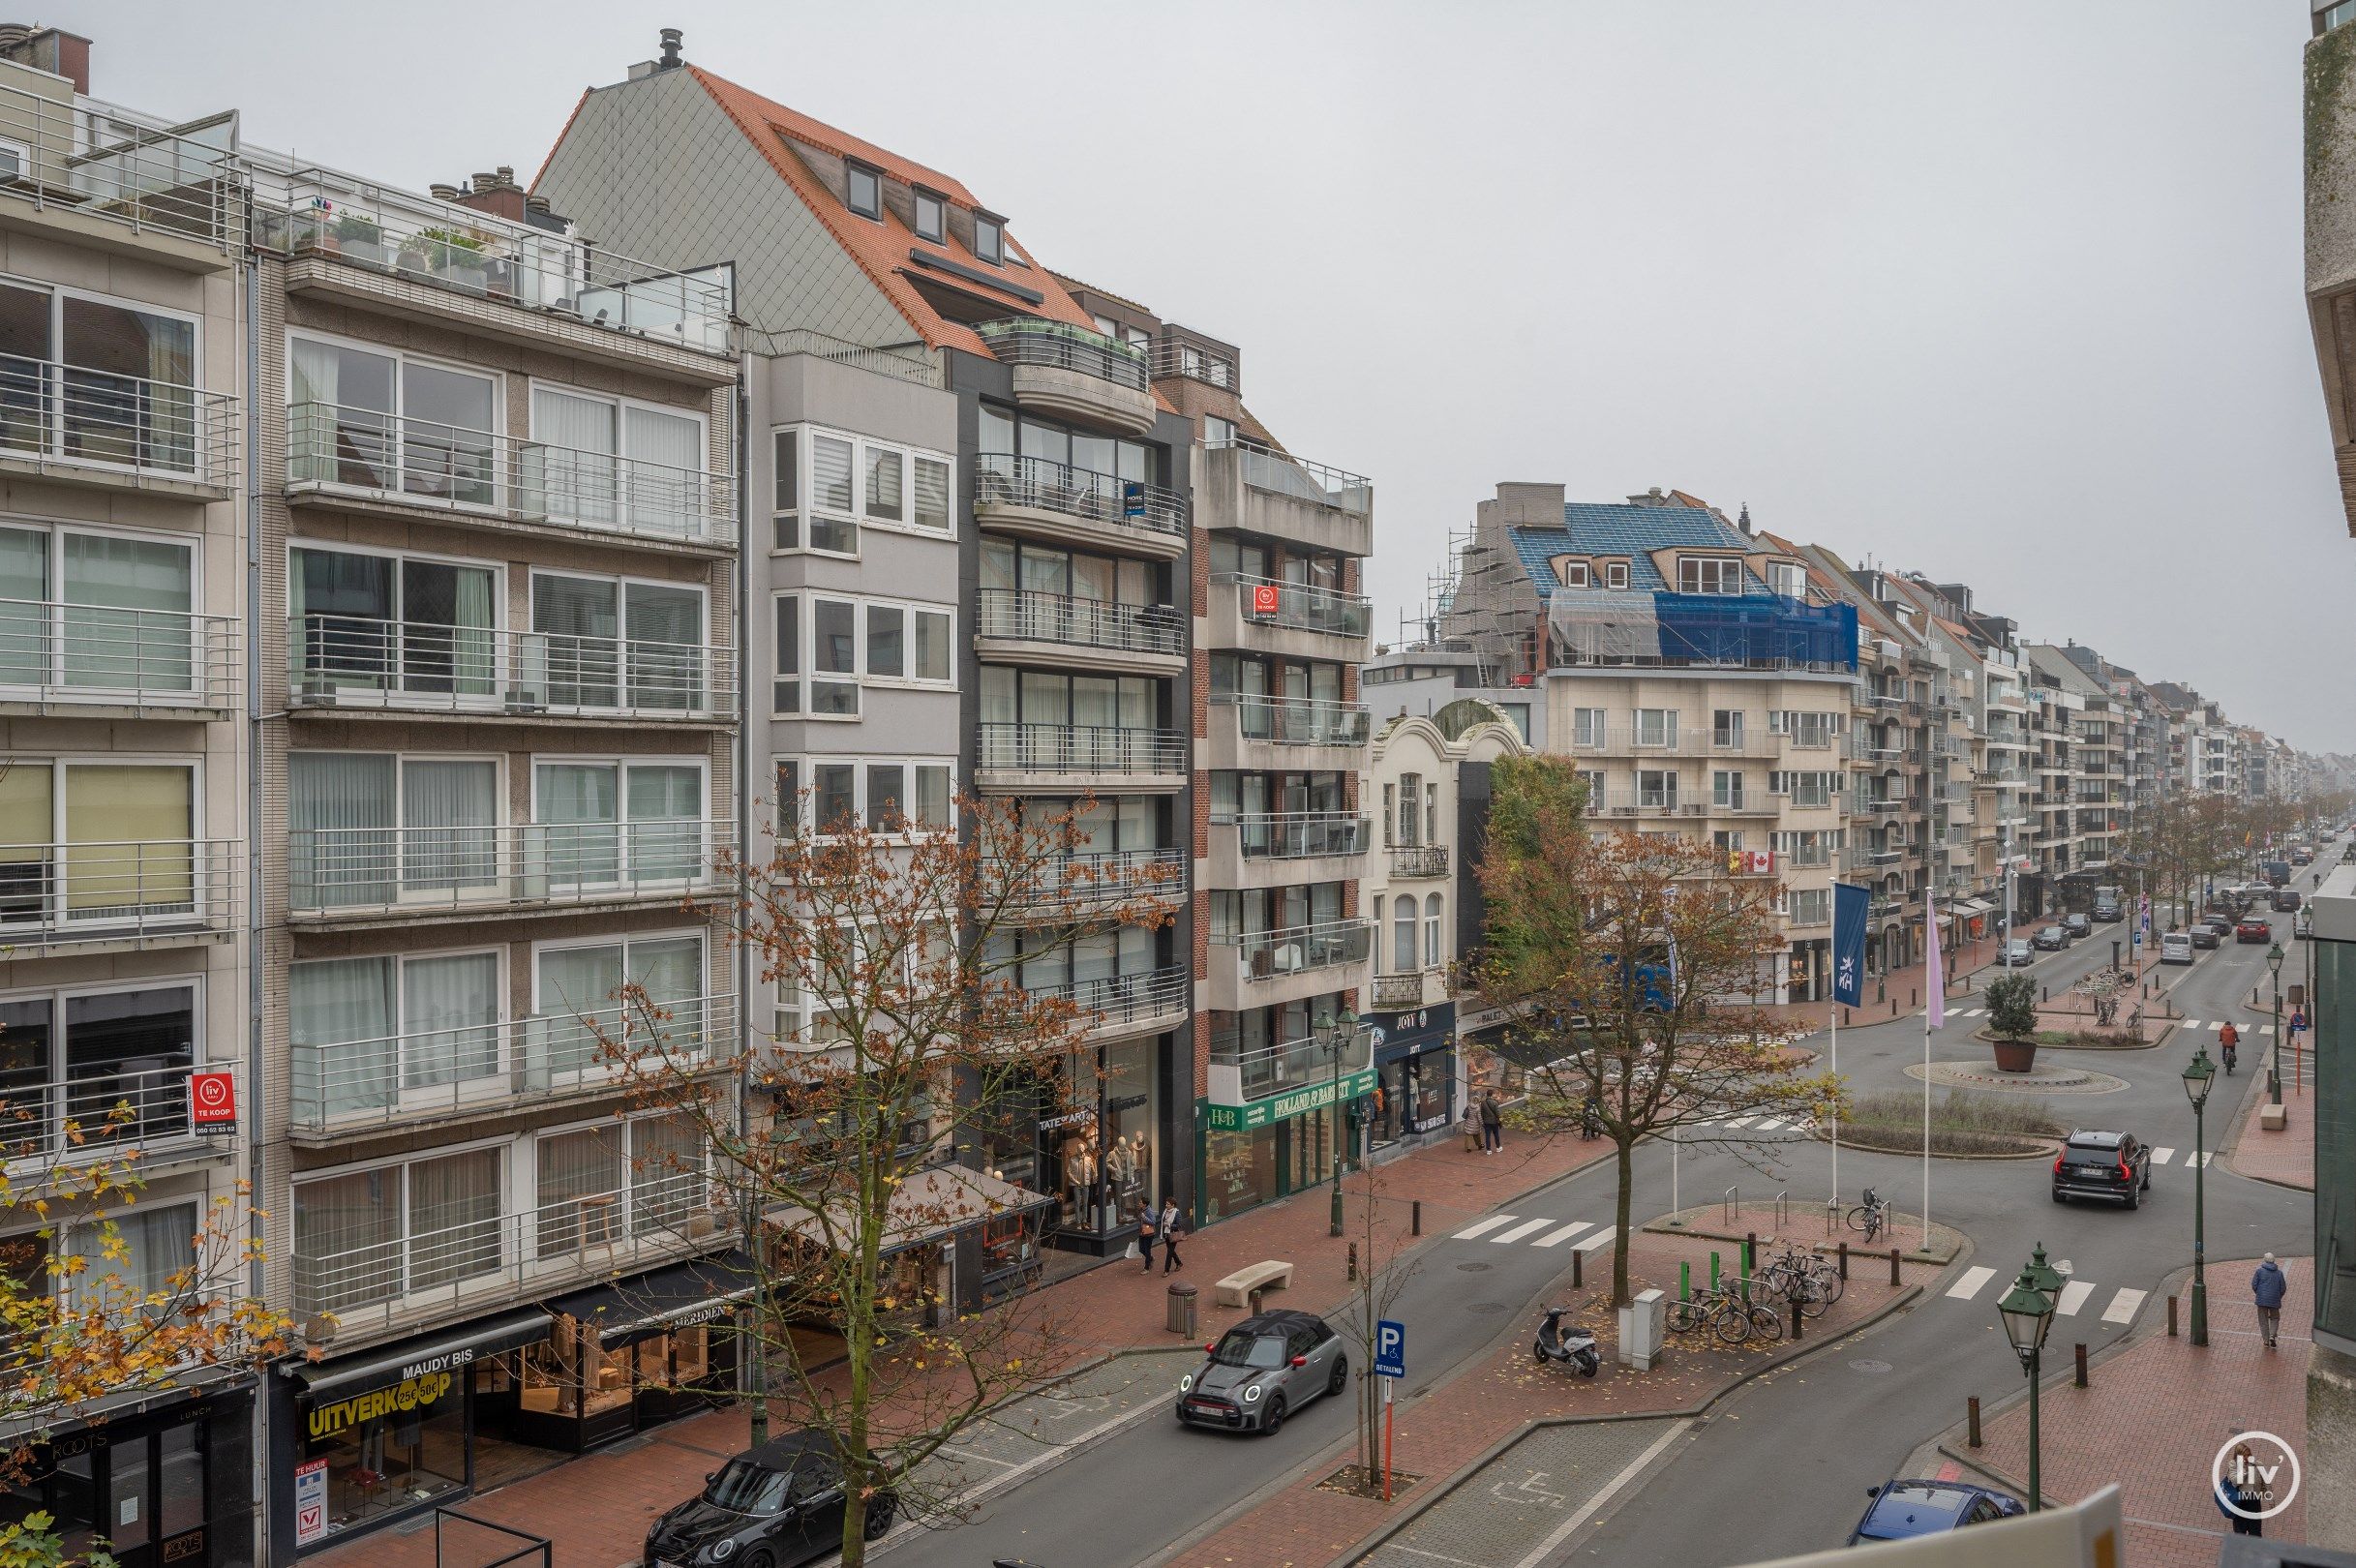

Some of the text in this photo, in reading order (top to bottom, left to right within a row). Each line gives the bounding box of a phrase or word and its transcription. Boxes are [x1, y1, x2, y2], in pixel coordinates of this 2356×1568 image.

[1274, 1091, 1312, 1119] HOLLAND
[1039, 1117, 1062, 1131] TATE
[1069, 1110, 1087, 1124] ART
[1381, 1327, 1400, 1356] P
[403, 1348, 473, 1380] MAUDY BIS
[1375, 1364, 1403, 1374] BETALEND
[399, 1382, 438, 1404] 25€ 50€
[180, 1406, 212, 1422] LUNCH
[52, 1432, 107, 1460] ROOTS
[296, 1461, 326, 1476] TE HUUR
